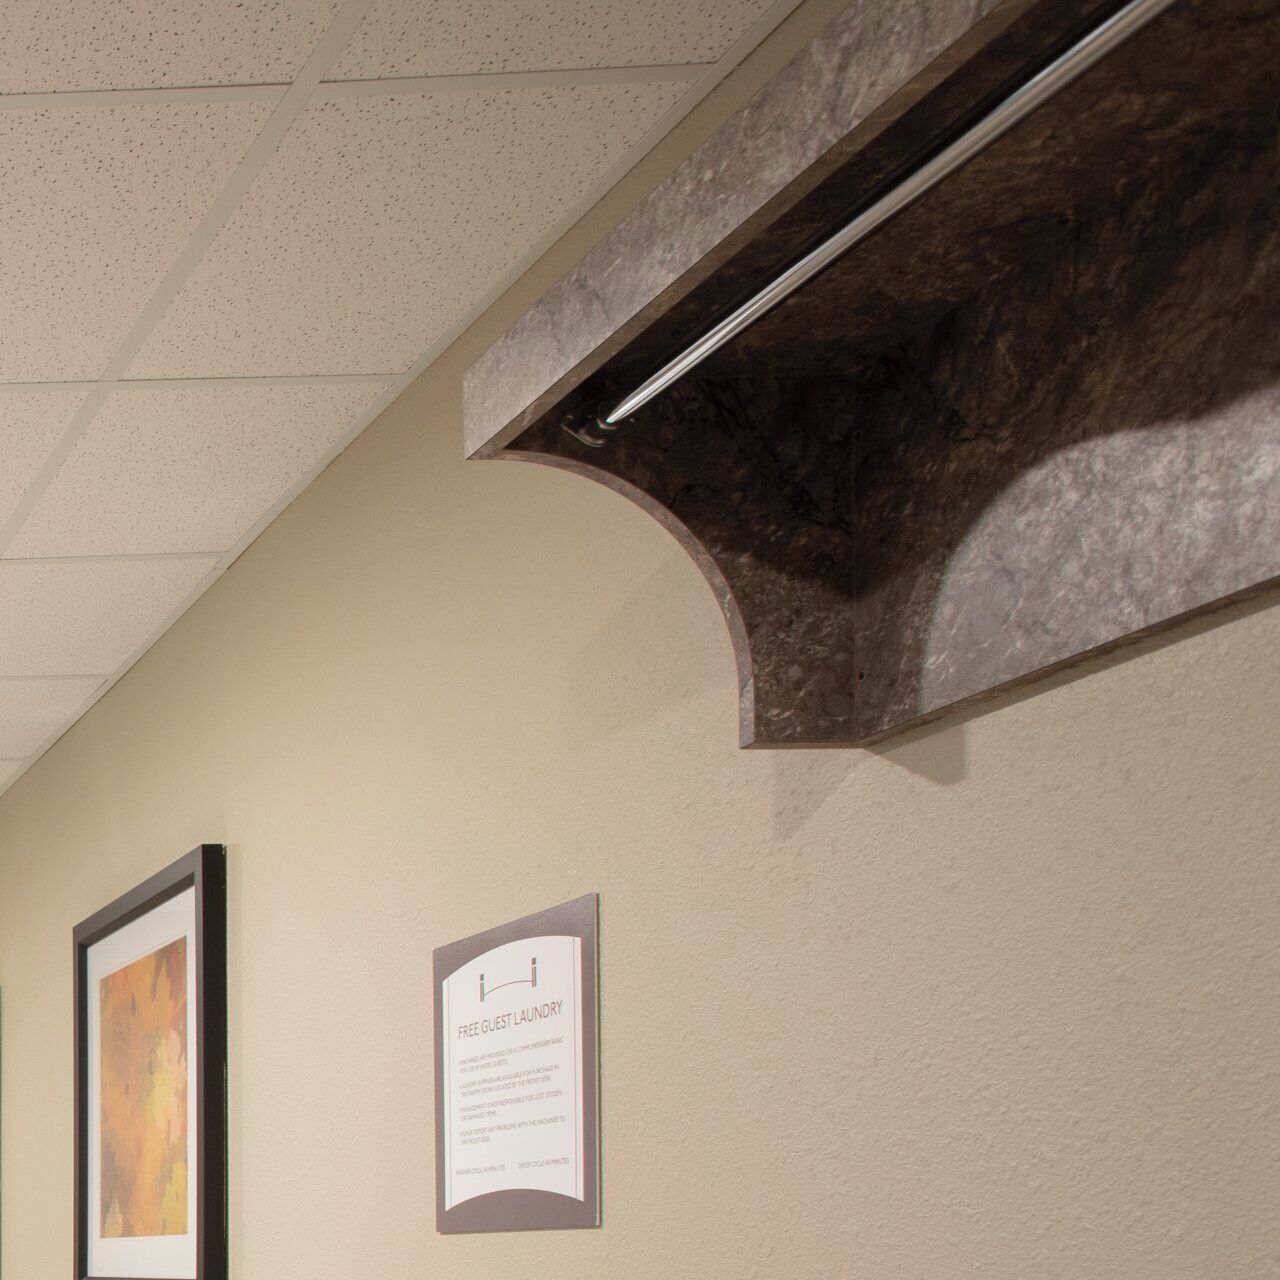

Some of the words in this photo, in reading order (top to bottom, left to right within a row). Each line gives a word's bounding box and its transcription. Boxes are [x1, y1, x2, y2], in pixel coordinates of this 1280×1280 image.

[459, 1022, 480, 1040] FREE
[481, 1013, 512, 1034] GUEST
[514, 999, 563, 1026] LAUNDRY
